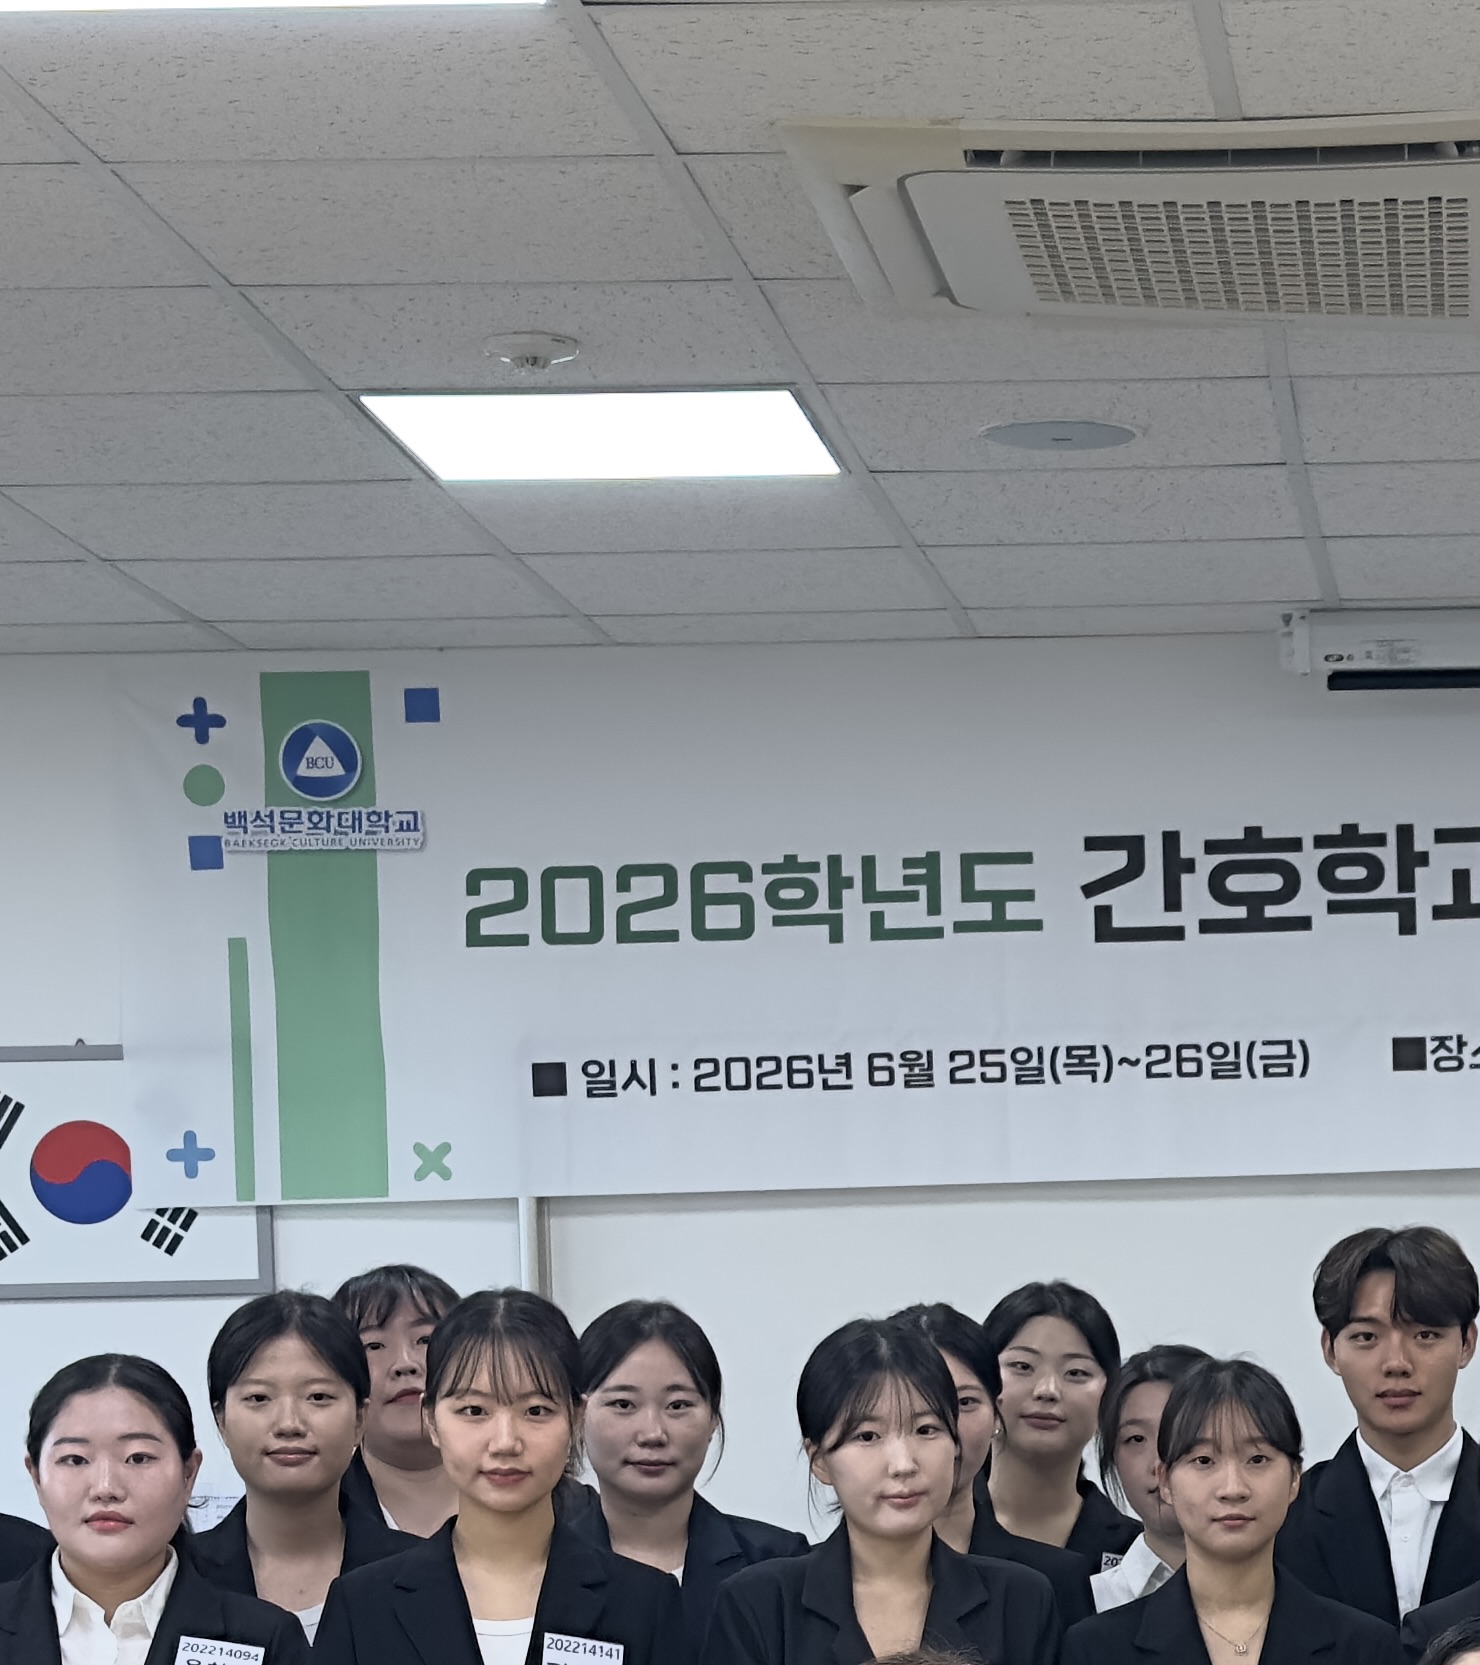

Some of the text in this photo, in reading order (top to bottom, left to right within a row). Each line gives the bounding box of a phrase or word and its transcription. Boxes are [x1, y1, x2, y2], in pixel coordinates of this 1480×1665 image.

[305, 756, 335, 770] BCU
[223, 809, 421, 835] 백석문화대학교
[224, 836, 421, 848] BAEKSEOK CULTURE UNIVERSITY
[465, 850, 1044, 948] 2026학년도
[581, 1057, 658, 1099] 일시
[693, 1052, 854, 1093] 2026년
[866, 1049, 936, 1090] 6월
[948, 1038, 1311, 1086] 25일(목)~26일(금)
[181, 1642, 259, 1662] 202214094
[546, 1637, 620, 1661] 202214141
